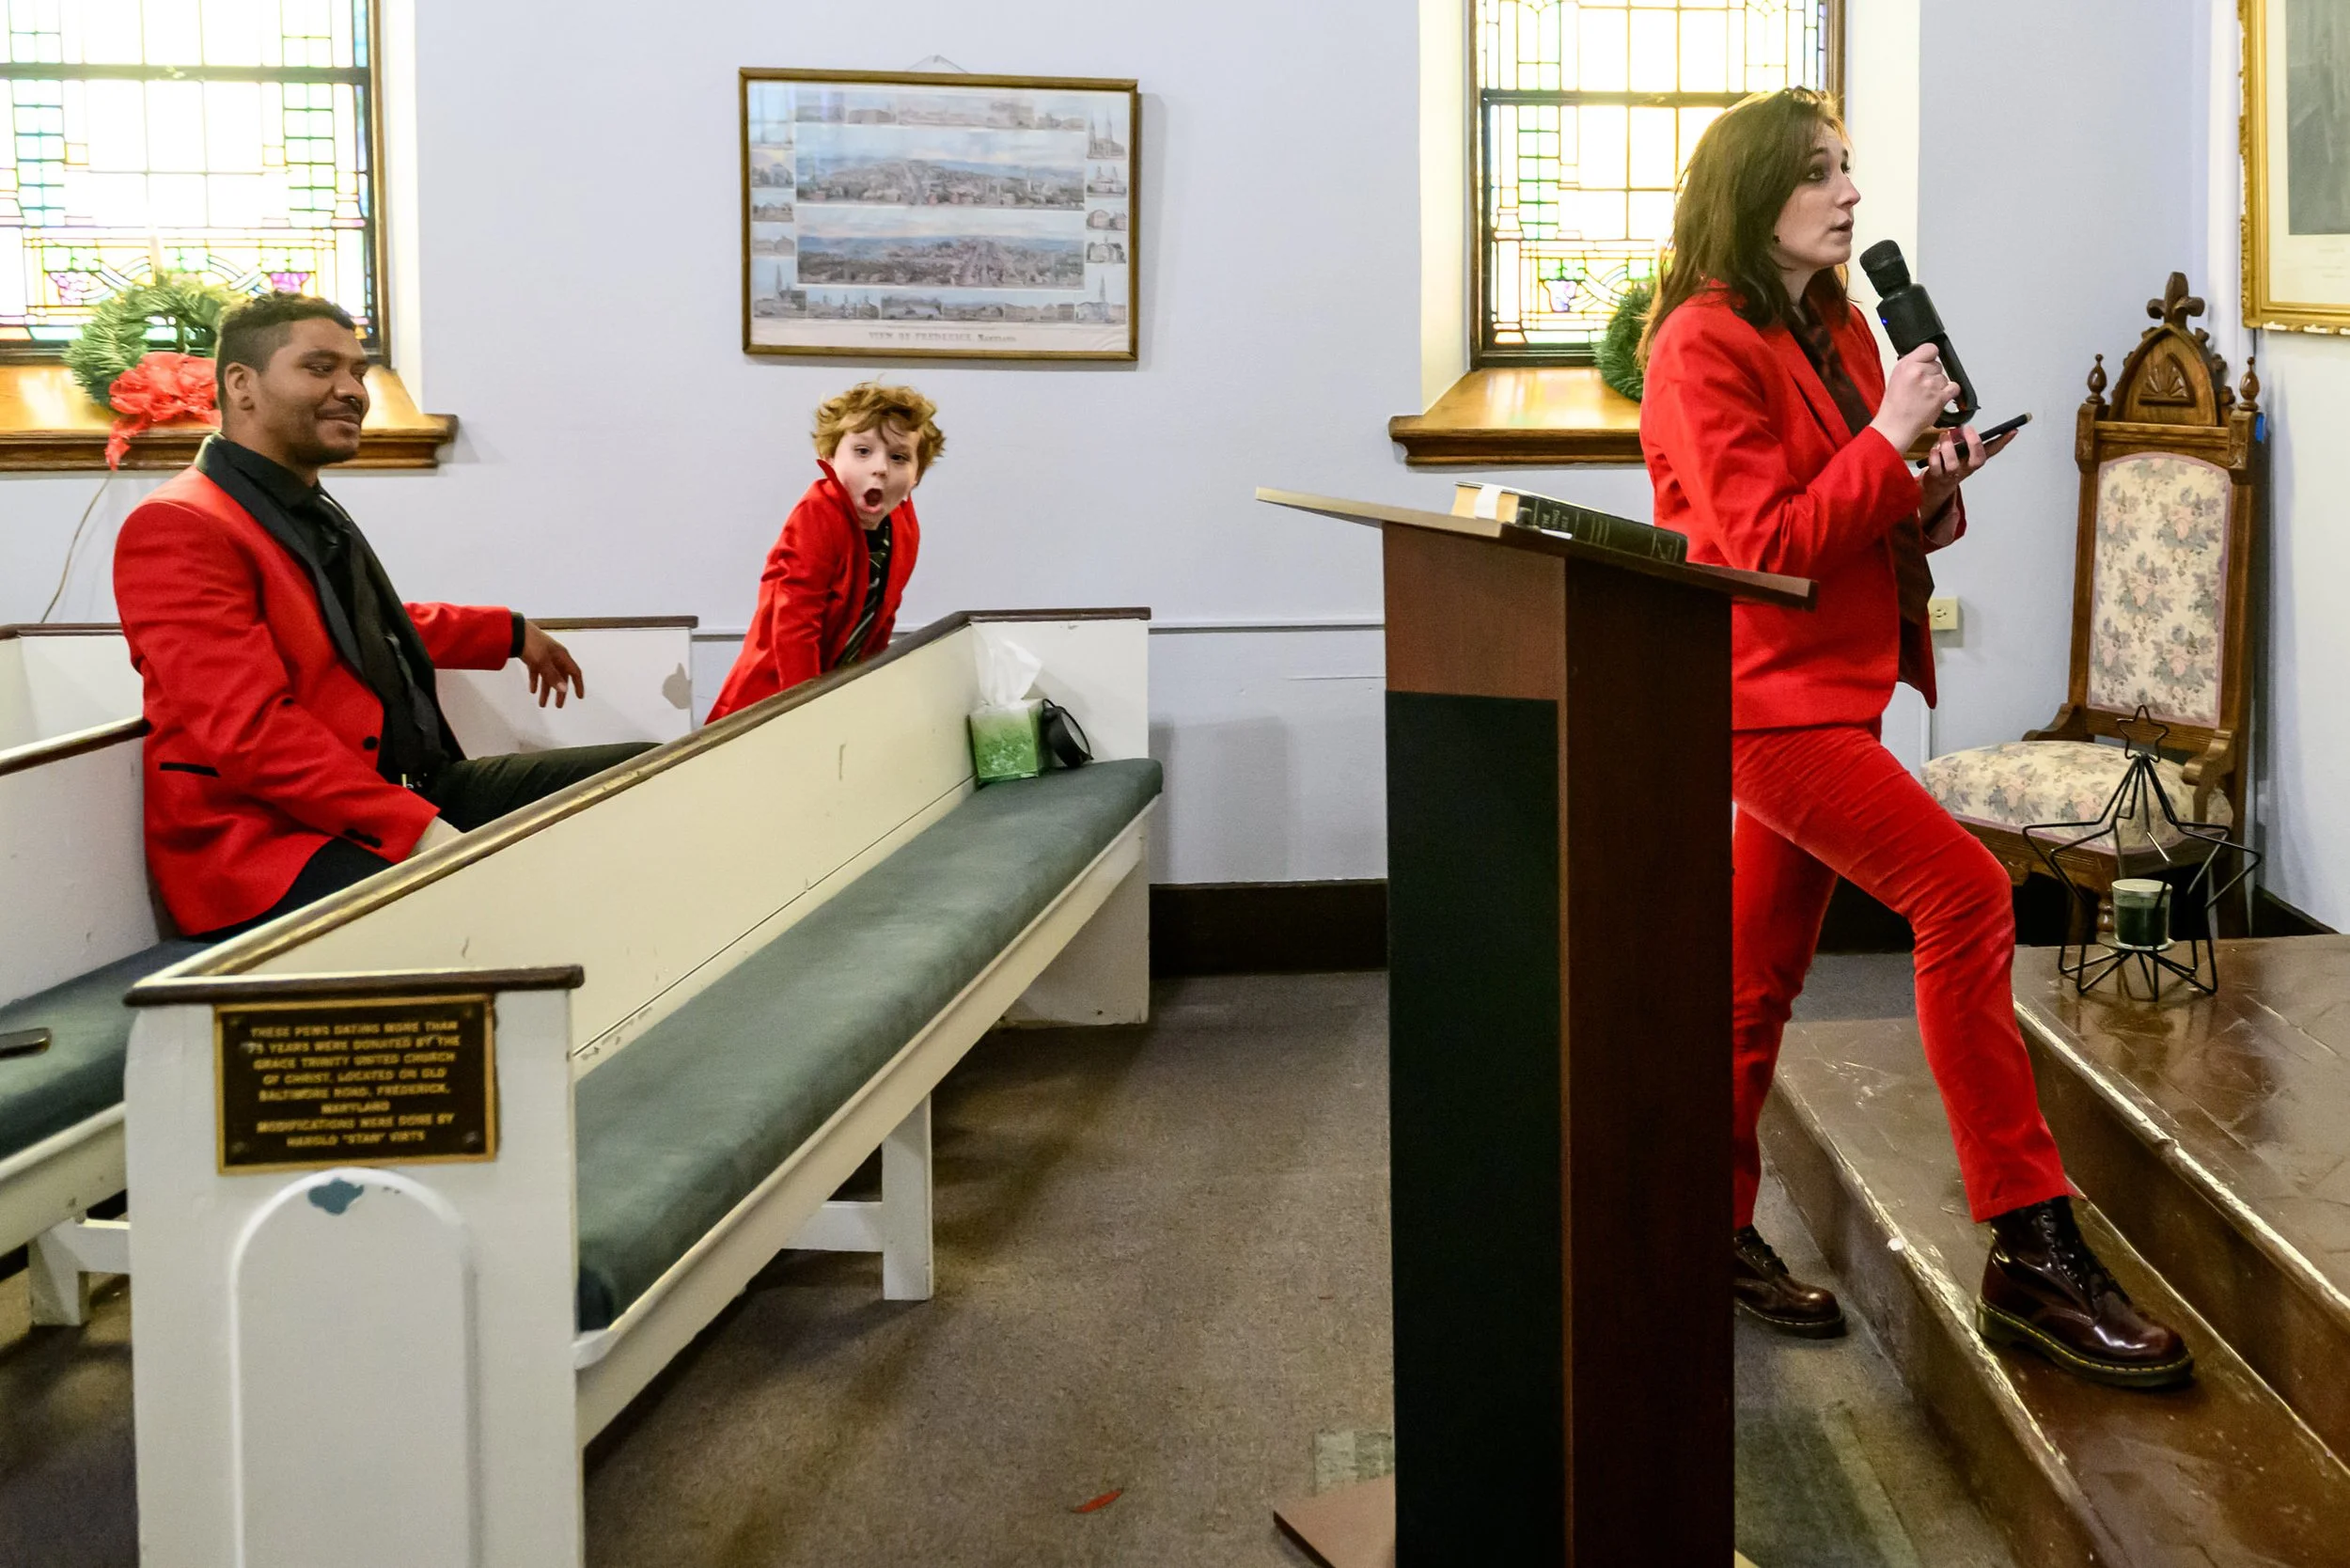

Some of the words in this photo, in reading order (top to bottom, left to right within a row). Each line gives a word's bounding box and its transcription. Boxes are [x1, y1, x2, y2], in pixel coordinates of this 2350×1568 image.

[869, 331, 893, 340] VIEW
[899, 332, 911, 341] OF
[250, 1027, 290, 1038] THESE
[294, 1025, 330, 1036] PEWS
[334, 1023, 380, 1035] DATING
[384, 1022, 419, 1033] MORE
[425, 1020, 459, 1032] THAN
[269, 1041, 309, 1053] YEARS
[314, 1040, 348, 1052] WERE
[352, 1036, 412, 1050] DONATED
[415, 1035, 434, 1048] BY
[437, 1034, 461, 1047] THE
[253, 1058, 296, 1070] GRACE
[301, 1056, 350, 1068] TRINITY
[353, 1053, 400, 1066] UNITED
[403, 1051, 456, 1064] CHURCH
[262, 1074, 279, 1086] OF
[284, 1072, 335, 1084] CHRIST,
[337, 1070, 395, 1082] LOCATED
[399, 1068, 418, 1079] ON
[421, 1067, 447, 1078] OLD
[258, 1089, 329, 1103] BALTIMORE
[334, 1086, 372, 1098] ROAD,
[377, 1083, 451, 1096] FREDERICK,
[321, 1100, 391, 1115] MARYLAND
[256, 1119, 355, 1134] MODIFICATIONS
[359, 1116, 394, 1128] WERE
[399, 1113, 432, 1126] DONE
[436, 1112, 455, 1125] BY
[287, 1135, 338, 1147] HAROLD
